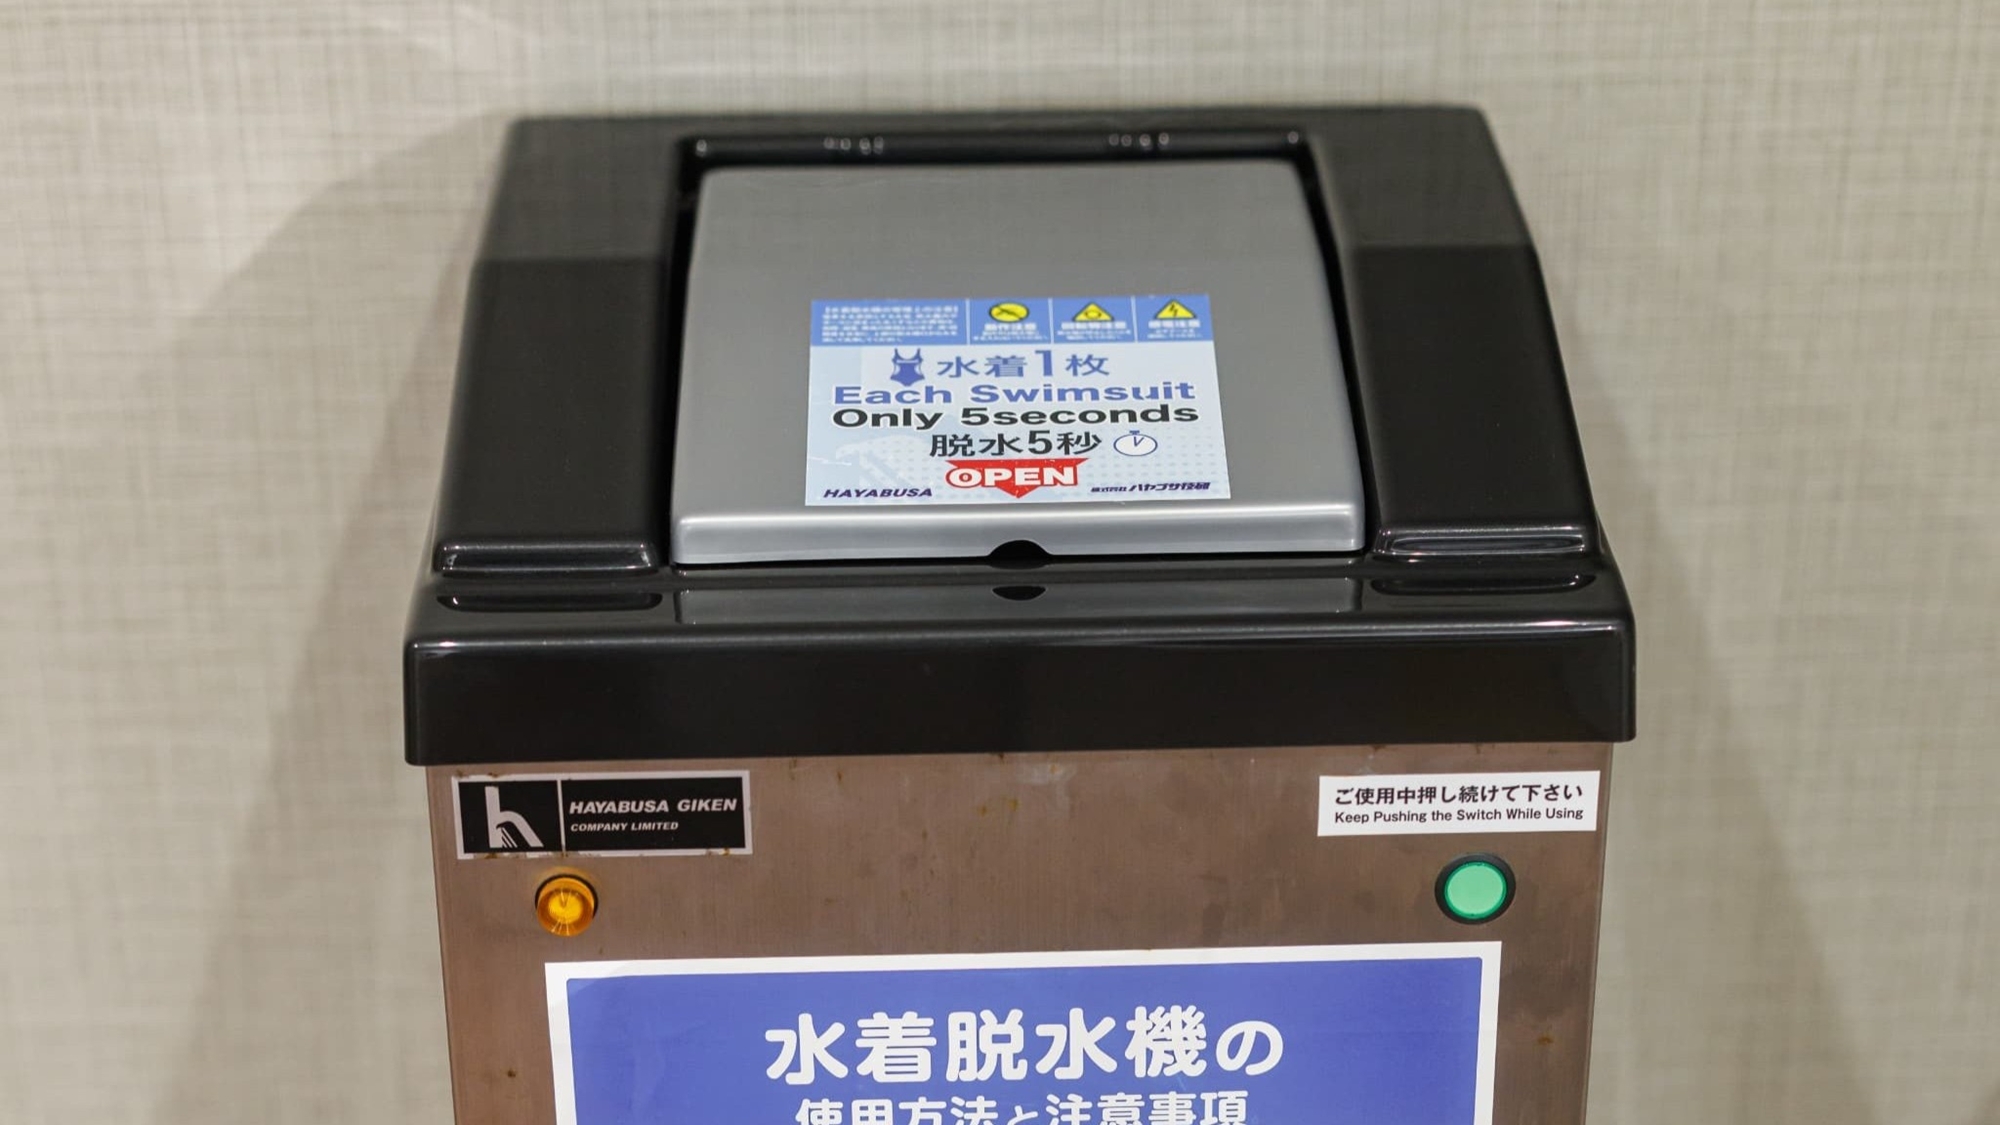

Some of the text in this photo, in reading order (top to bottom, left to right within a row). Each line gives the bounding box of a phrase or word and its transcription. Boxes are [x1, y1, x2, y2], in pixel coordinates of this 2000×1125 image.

[937, 350, 1110, 378] 水着1枚
[833, 381, 1197, 405] Each Swimsuit
[832, 404, 1200, 430] Only 5seconds
[929, 430, 1102, 458] 脱水5秒
[947, 465, 1076, 489] OPEN
[822, 487, 933, 499] HAYABUSA
[569, 798, 737, 814] HAYABUSA GIKEN
[1335, 784, 1583, 806] ご使用中押し続けて下さい
[570, 821, 679, 832] COMPANY LIMITED
[1335, 807, 1584, 824] Keep Pushing the Switch While Using
[765, 1005, 1284, 1085] 水着脱水機の
[795, 1090, 1249, 1125] 使用方法と注意事項
